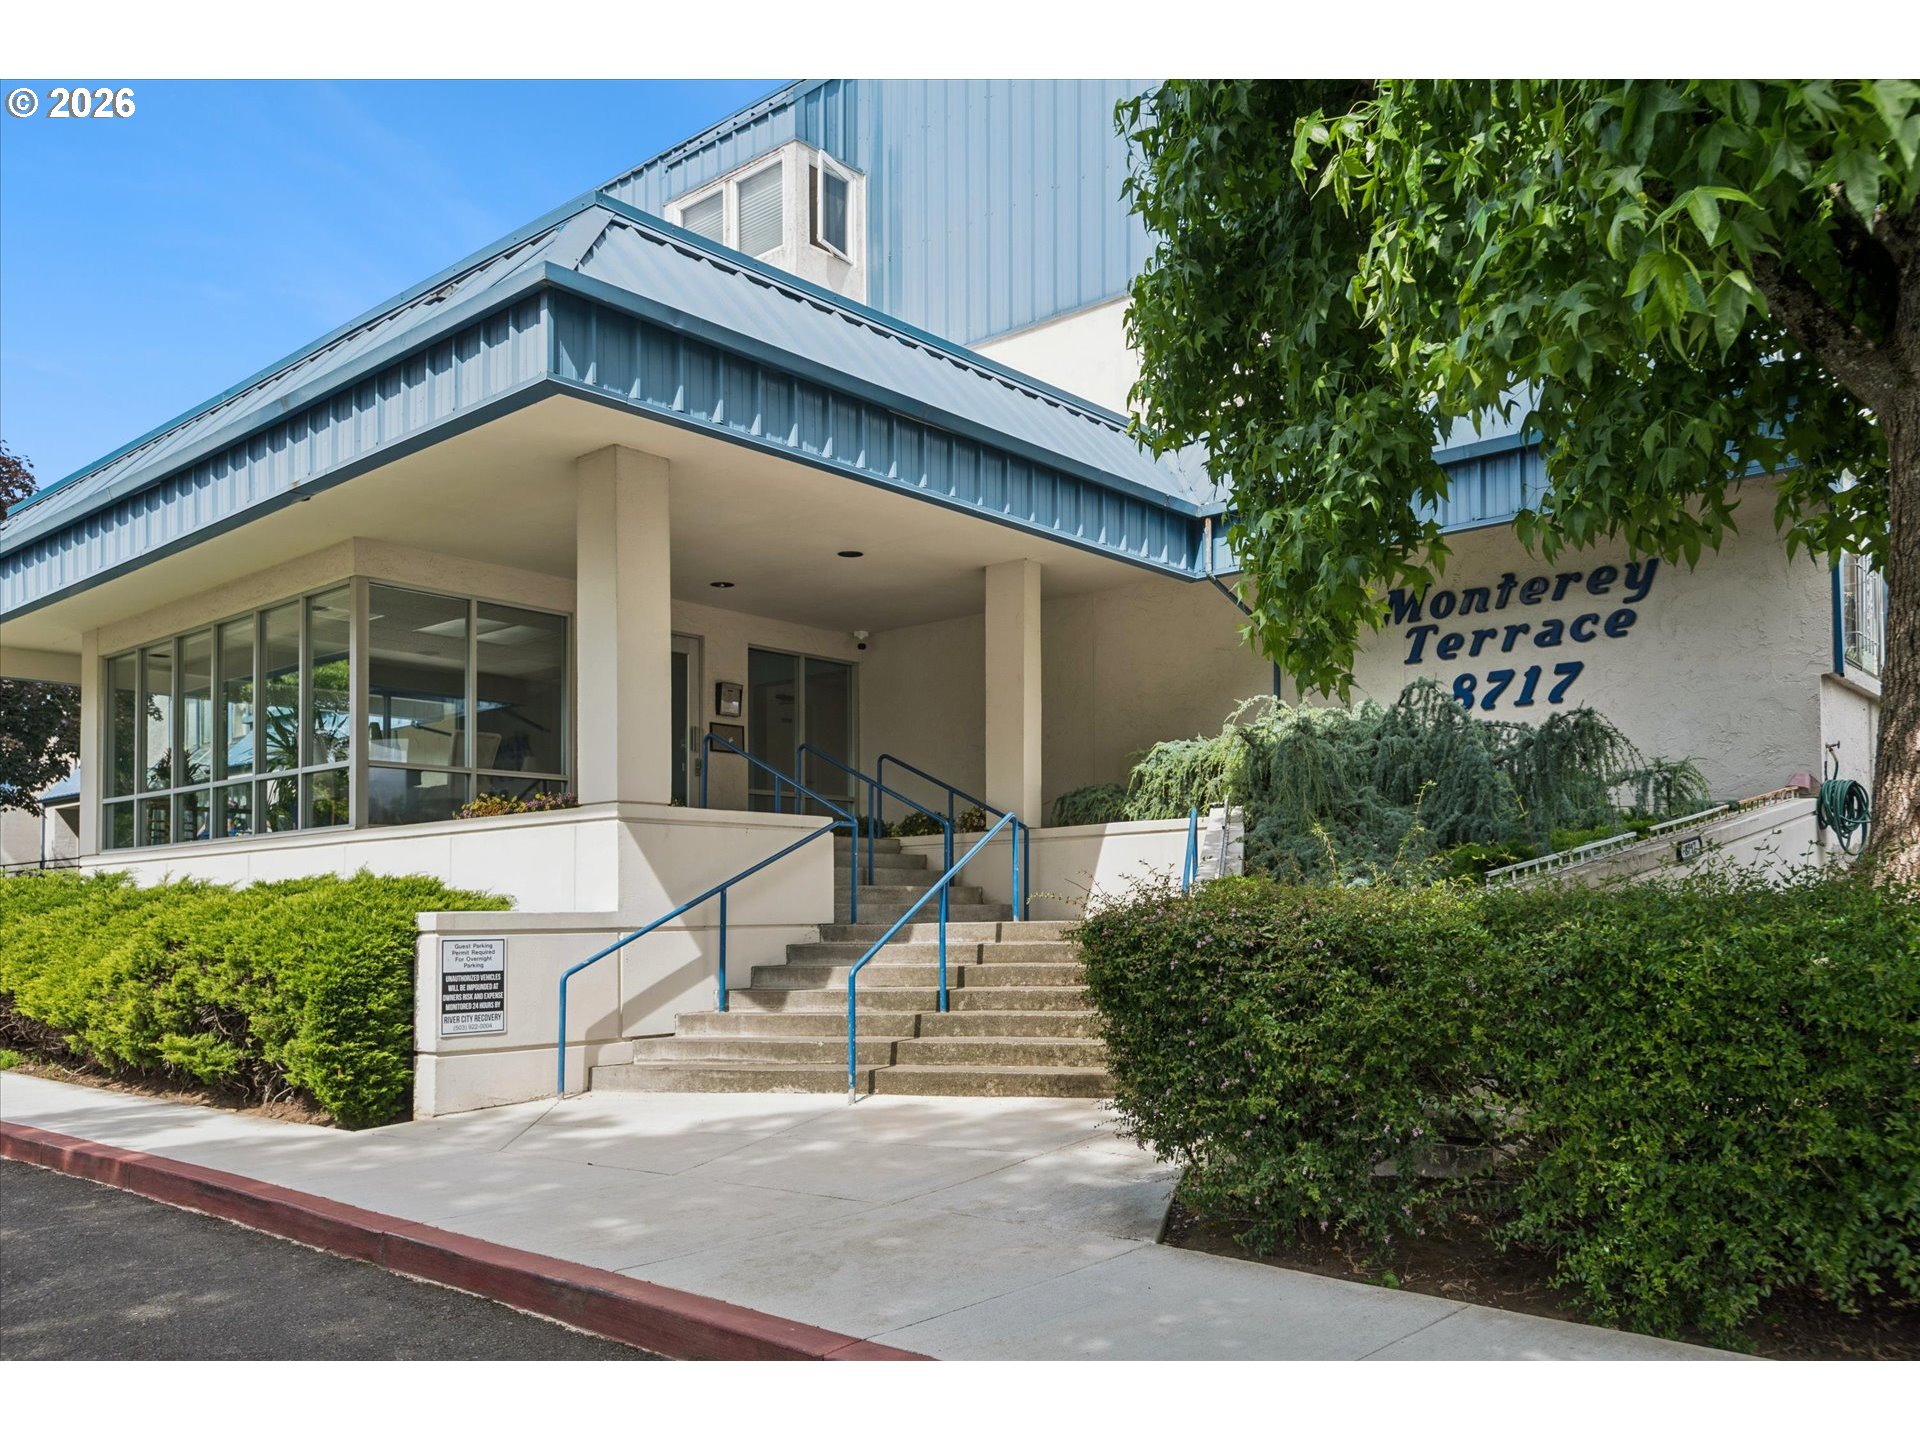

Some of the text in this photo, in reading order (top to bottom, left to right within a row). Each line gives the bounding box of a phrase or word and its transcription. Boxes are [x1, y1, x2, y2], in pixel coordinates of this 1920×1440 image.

[1382, 558, 1659, 625] Monterey
[1404, 608, 1638, 665] Terrace
[1452, 661, 1584, 711] 8717
[445, 973, 502, 982] UNAUTHORIZED VEHICLES
[466, 983, 492, 991] IMPOUNDED
[442, 994, 462, 1002] OWNERS
[484, 992, 504, 1000] EXPENSE
[446, 1002, 472, 1010] MONITORED
[444, 1013, 502, 1024] RIVER CITY RECOVERY
